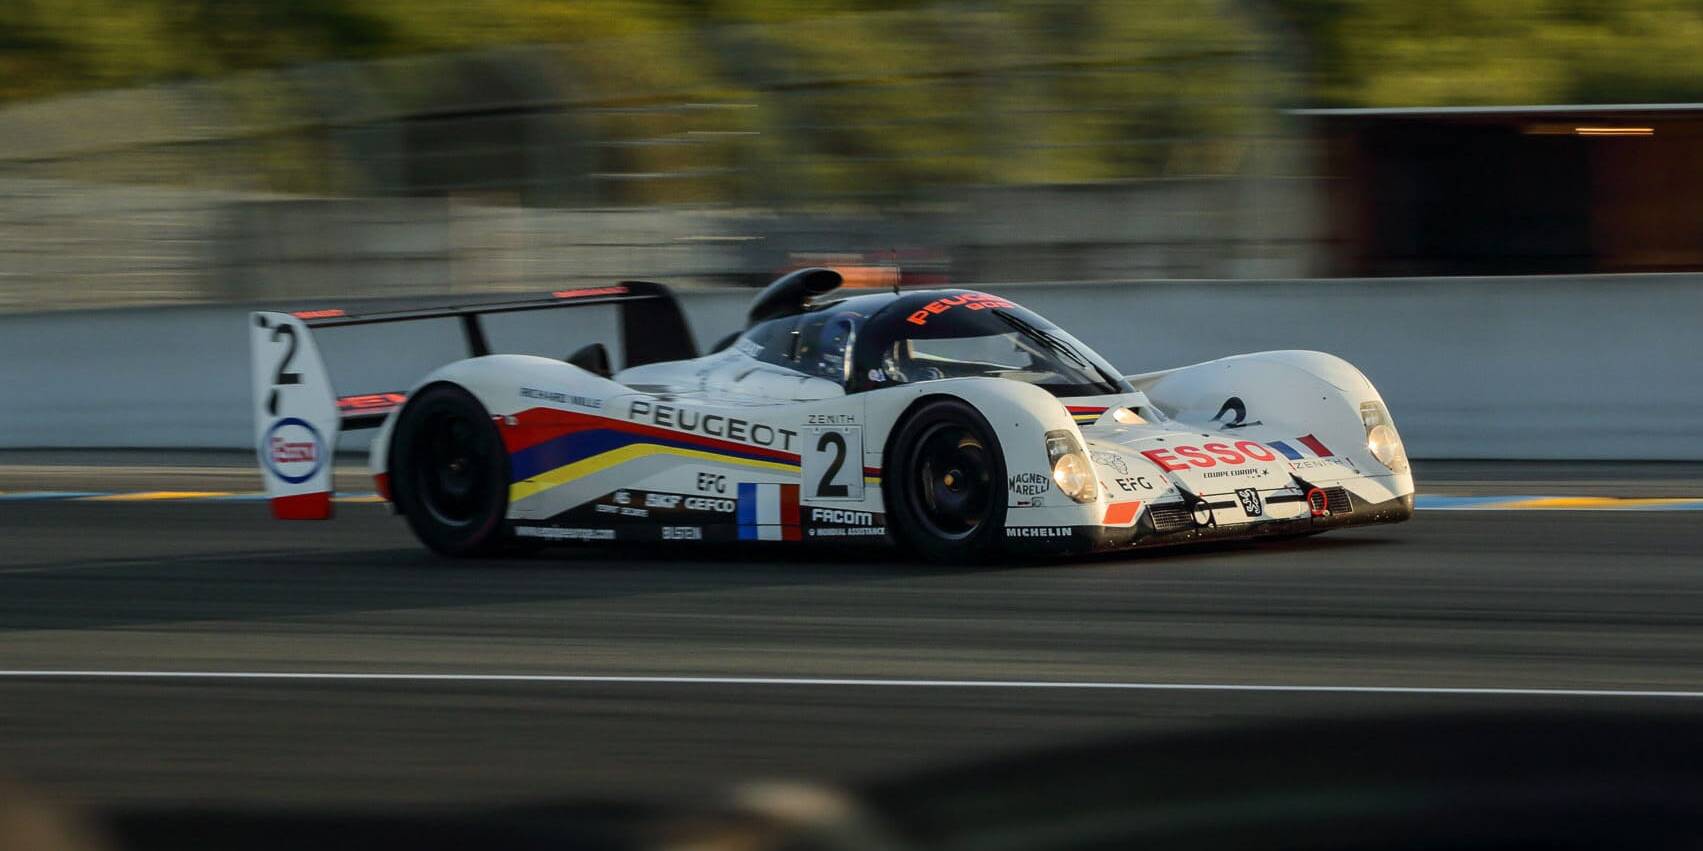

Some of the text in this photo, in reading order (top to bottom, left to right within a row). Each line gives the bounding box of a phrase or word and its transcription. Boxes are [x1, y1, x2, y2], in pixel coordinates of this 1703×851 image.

[905, 293, 1010, 325] PEUG
[271, 323, 303, 385] 2
[629, 401, 797, 450] PEUGEOT
[808, 414, 854, 424] ZENITH
[816, 431, 848, 497] 2
[1140, 441, 1276, 473] ESSO
[1296, 456, 1342, 470] ZENITH
[1009, 473, 1050, 490] MAGNETI
[1203, 468, 1259, 479] EQUIPE EUROPE
[697, 472, 727, 494] EFG
[1009, 478, 1050, 495] MARELLI
[1115, 476, 1154, 492] EFG
[684, 497, 735, 512] GEFCO
[812, 508, 872, 526] FACOM
[1006, 527, 1073, 537] MICHELIN
